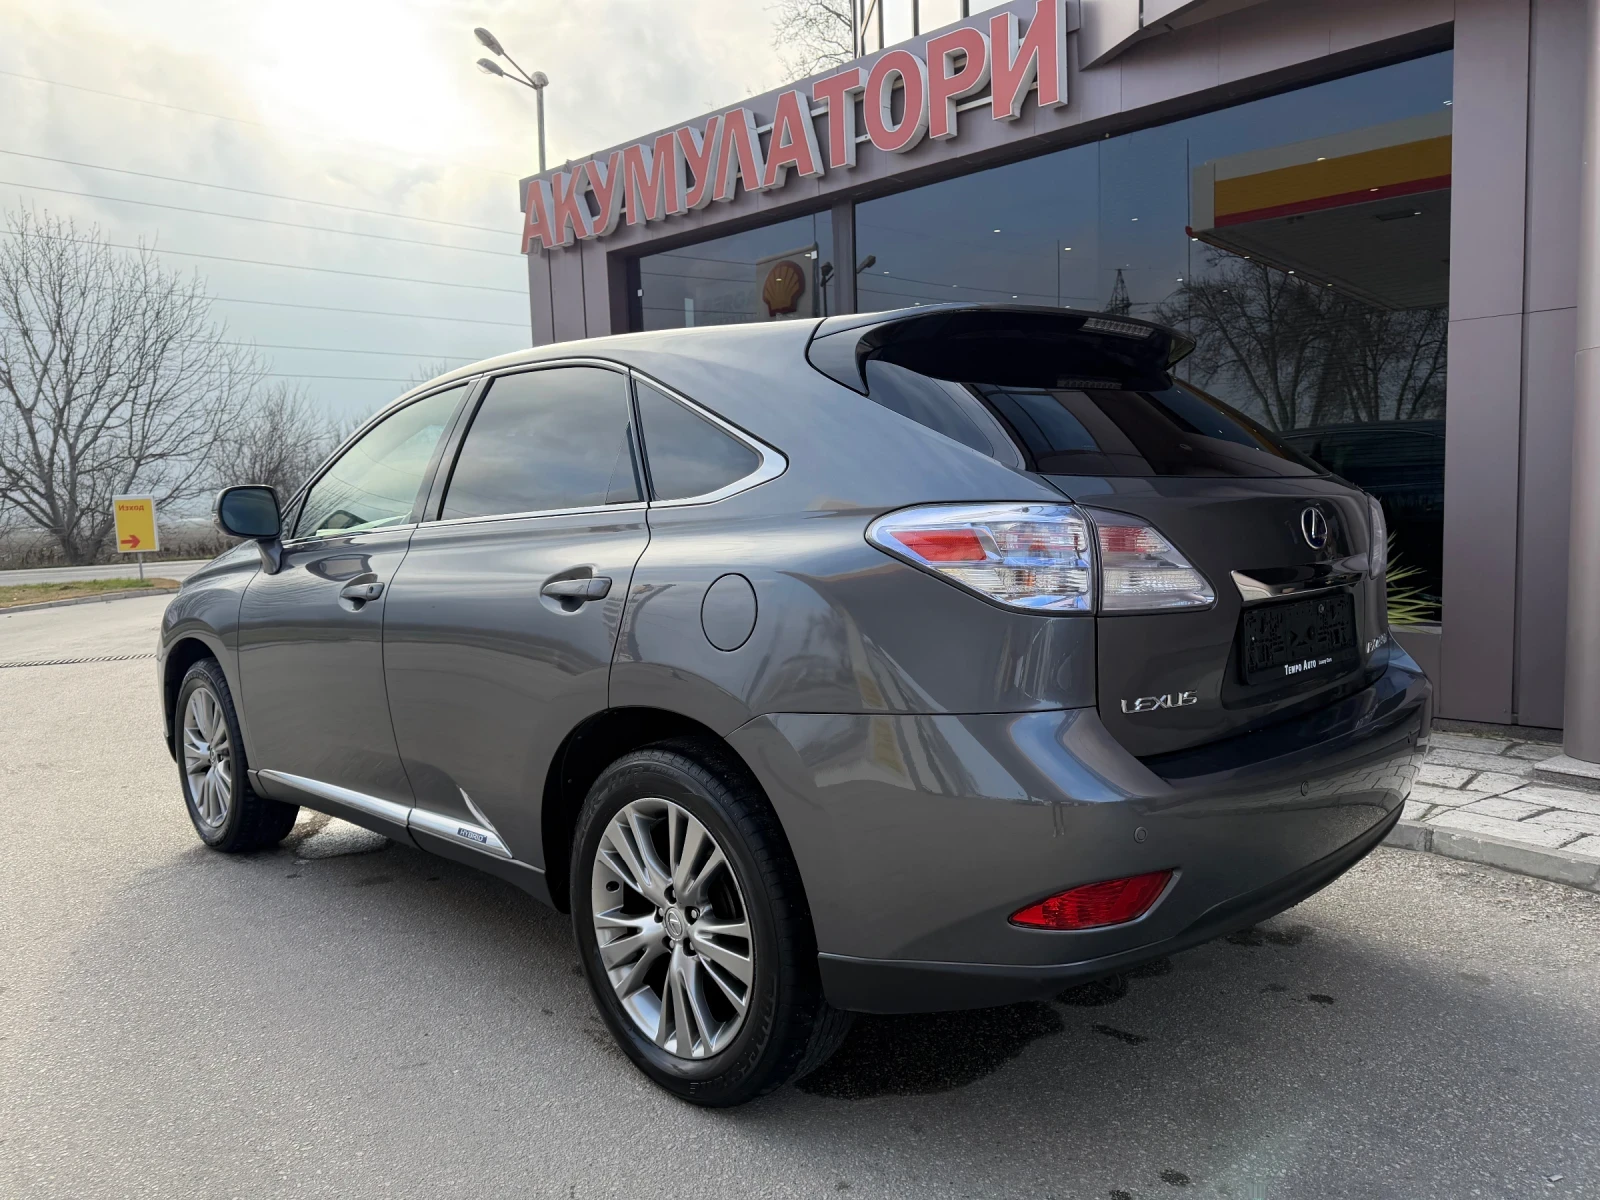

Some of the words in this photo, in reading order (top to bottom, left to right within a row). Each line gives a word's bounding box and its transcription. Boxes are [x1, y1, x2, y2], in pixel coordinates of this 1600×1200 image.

[521, 0, 1068, 254] АКУМУЛАТОРИ
[1120, 690, 1198, 713] LEXUS
[459, 828, 485, 842] HYBRID
